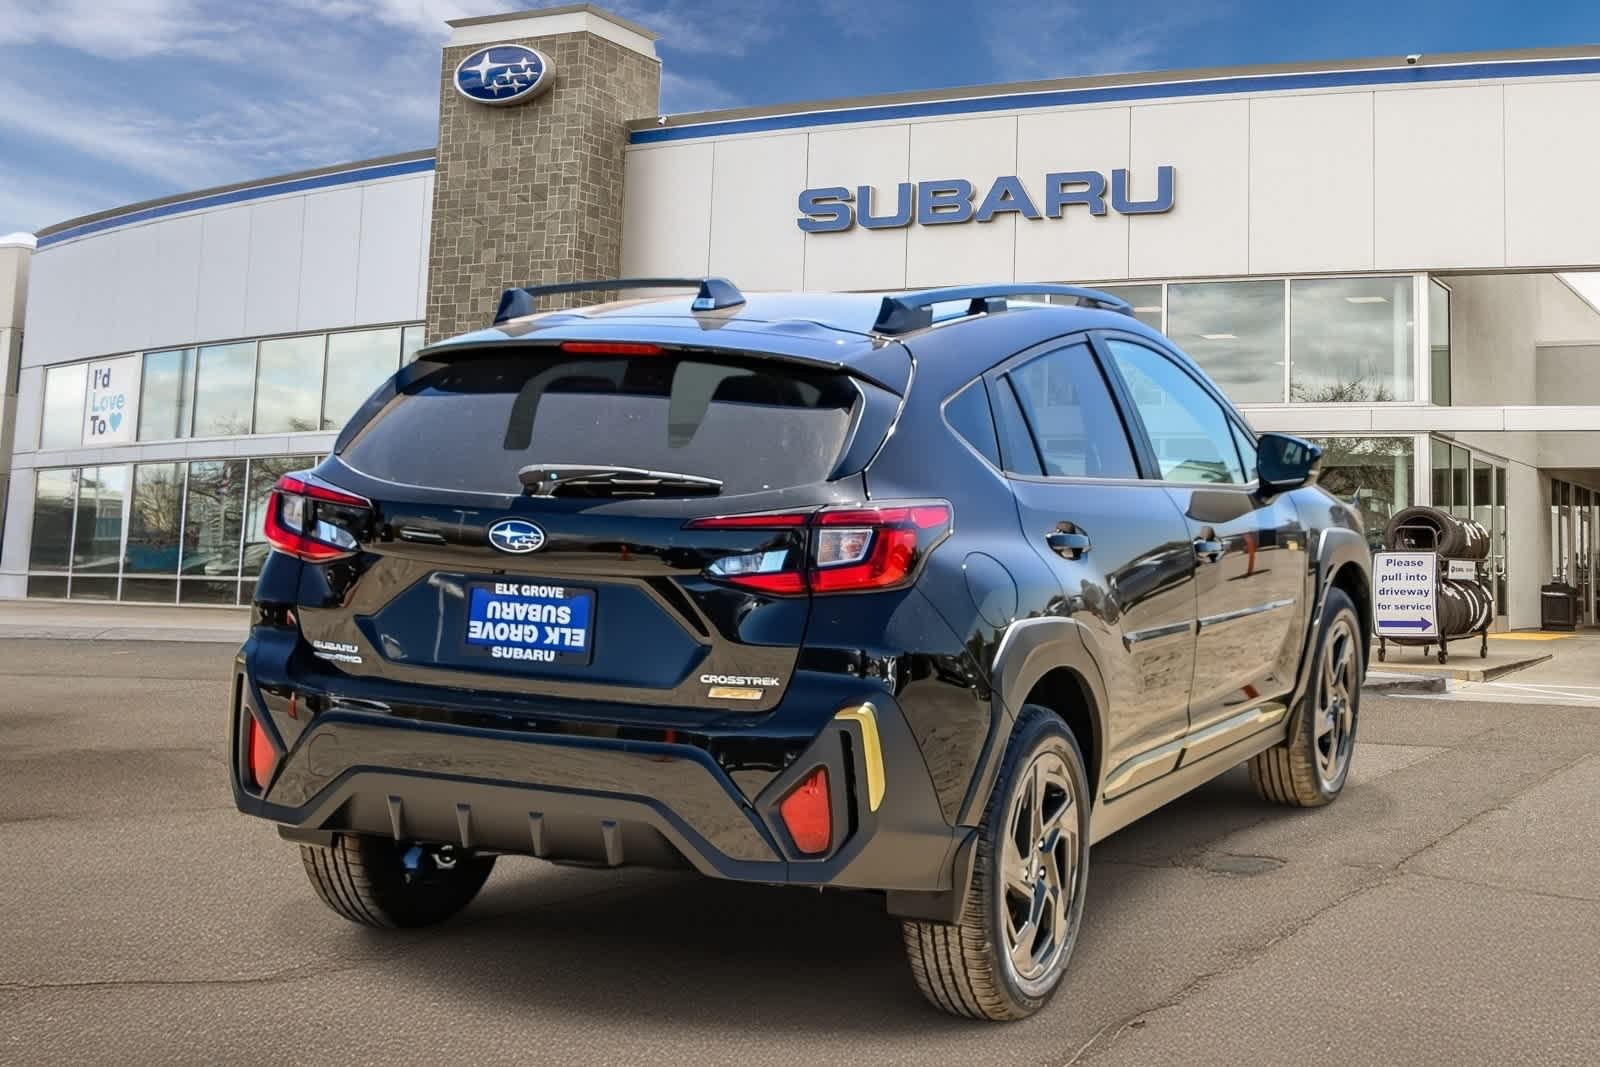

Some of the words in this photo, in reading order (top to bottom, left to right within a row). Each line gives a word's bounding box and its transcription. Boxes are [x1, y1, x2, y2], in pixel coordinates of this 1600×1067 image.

[797, 165, 1176, 233] SUBARU
[94, 367, 111, 389] I'd
[91, 391, 125, 412] Love
[90, 415, 106, 435] To
[1386, 558, 1424, 567] Please
[1381, 573, 1402, 583] pull
[1405, 573, 1428, 581] into
[495, 583, 520, 596] ELK
[521, 584, 565, 599] GROVE
[1378, 587, 1430, 597] driveway
[486, 600, 572, 625] SUBARU
[467, 620, 539, 643] GROVE
[543, 625, 586, 647] ELK
[491, 646, 556, 662] SUBARU
[700, 674, 780, 686] CROSSTREK
